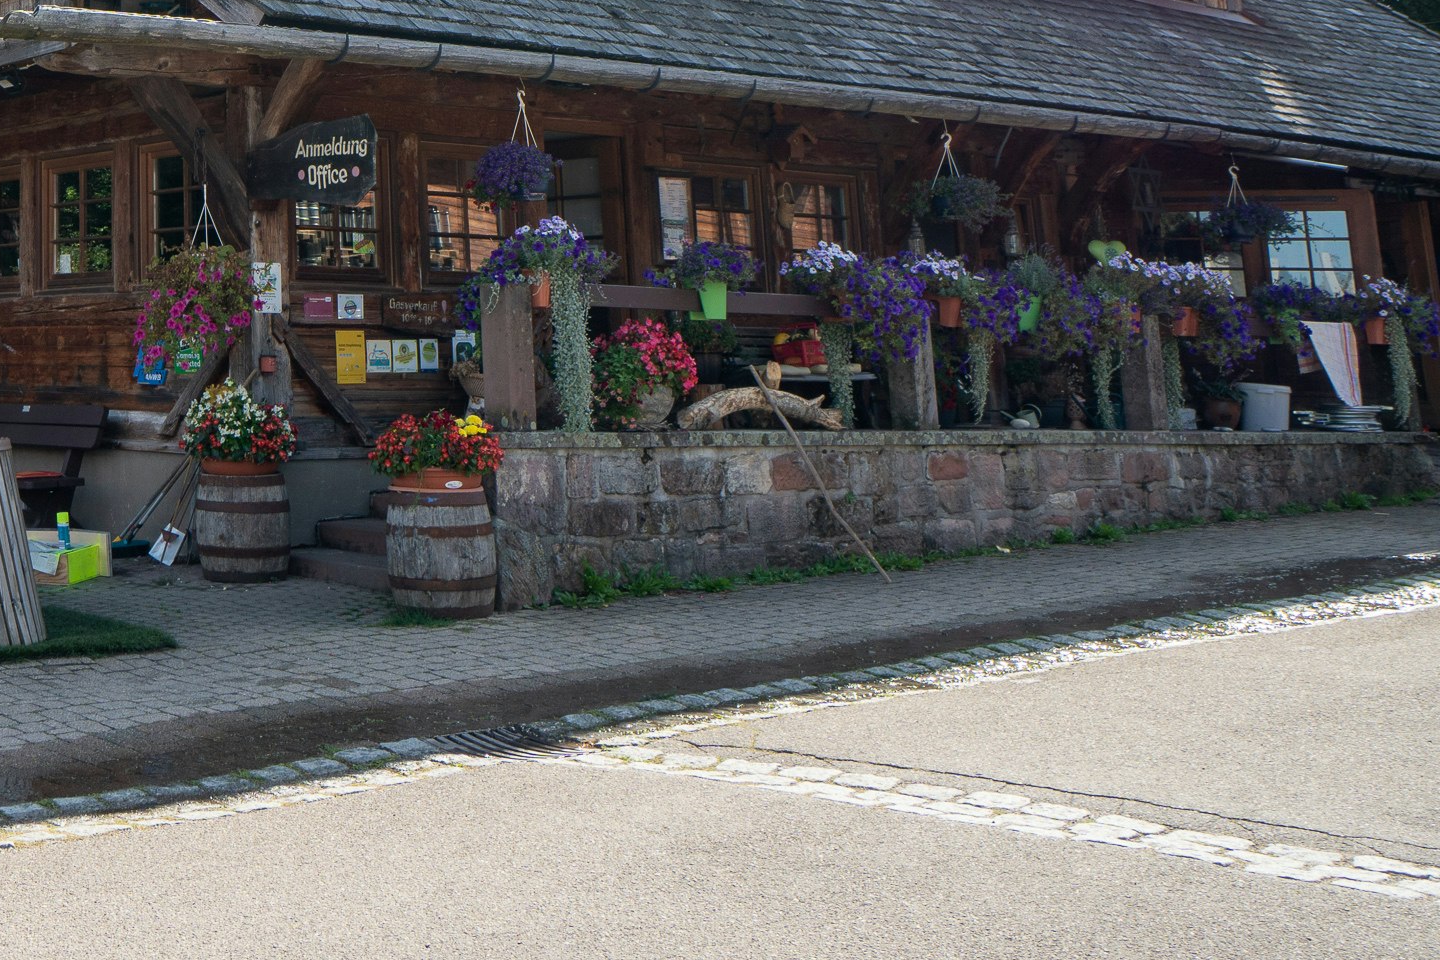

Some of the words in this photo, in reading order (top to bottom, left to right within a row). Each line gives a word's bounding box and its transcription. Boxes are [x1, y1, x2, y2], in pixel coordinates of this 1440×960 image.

[295, 136, 368, 158] Anmeldung
[307, 164, 348, 189] Office
[389, 297, 438, 311] Gasverkauf
